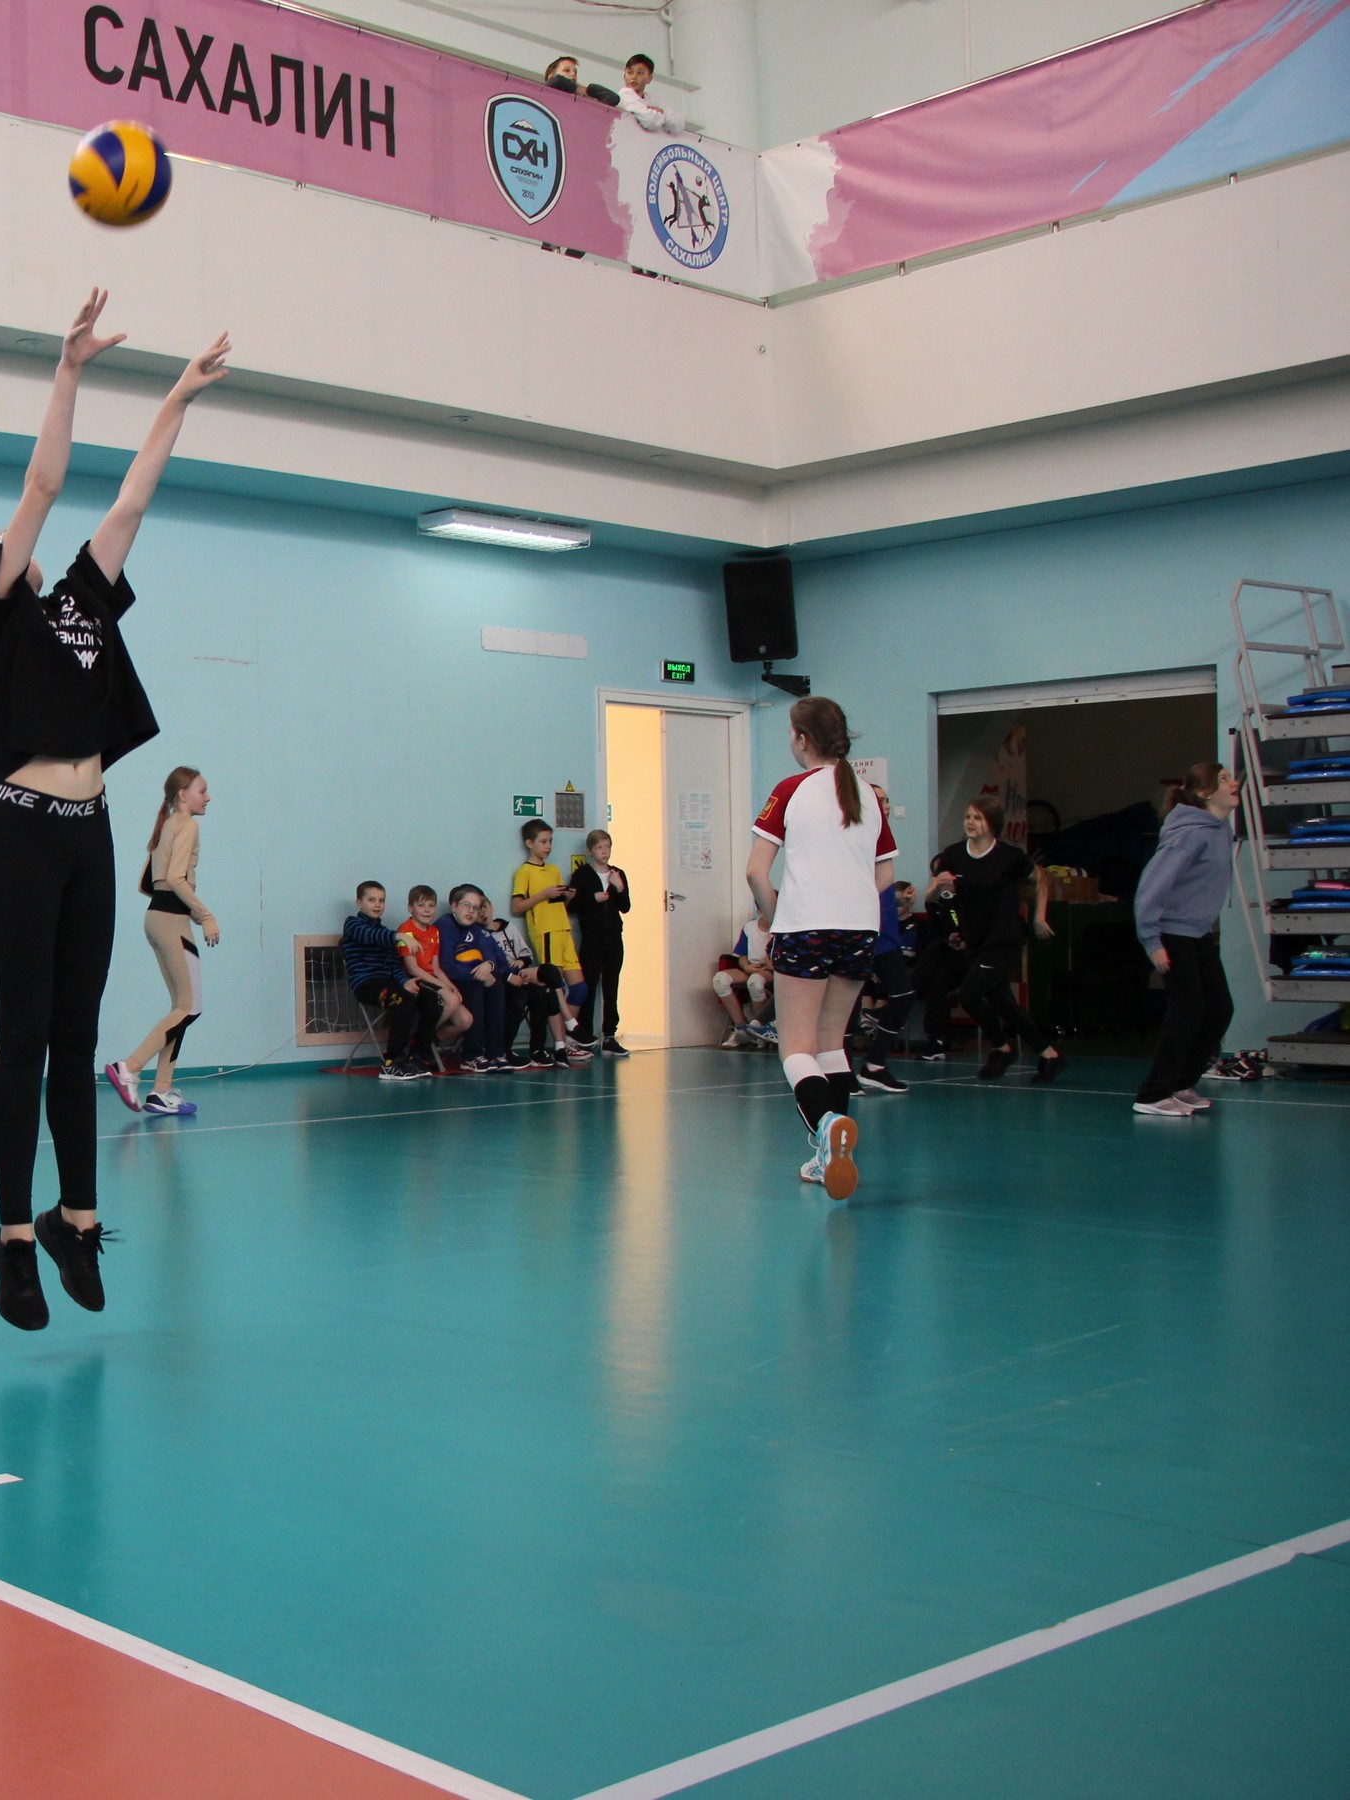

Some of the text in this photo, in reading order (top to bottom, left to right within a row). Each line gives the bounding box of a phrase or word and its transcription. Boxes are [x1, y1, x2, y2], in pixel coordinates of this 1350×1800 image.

[84, 4, 396, 158] САХАЛИН
[648, 147, 729, 227] ВОЛЕЙБОЛЬНЫЙ ЦЕНТР
[665, 238, 714, 267] САХАЛИН
[667, 663, 691, 673] ВЫХОД
[671, 671, 686, 680] EXIT
[47, 799, 96, 817] NIKE
